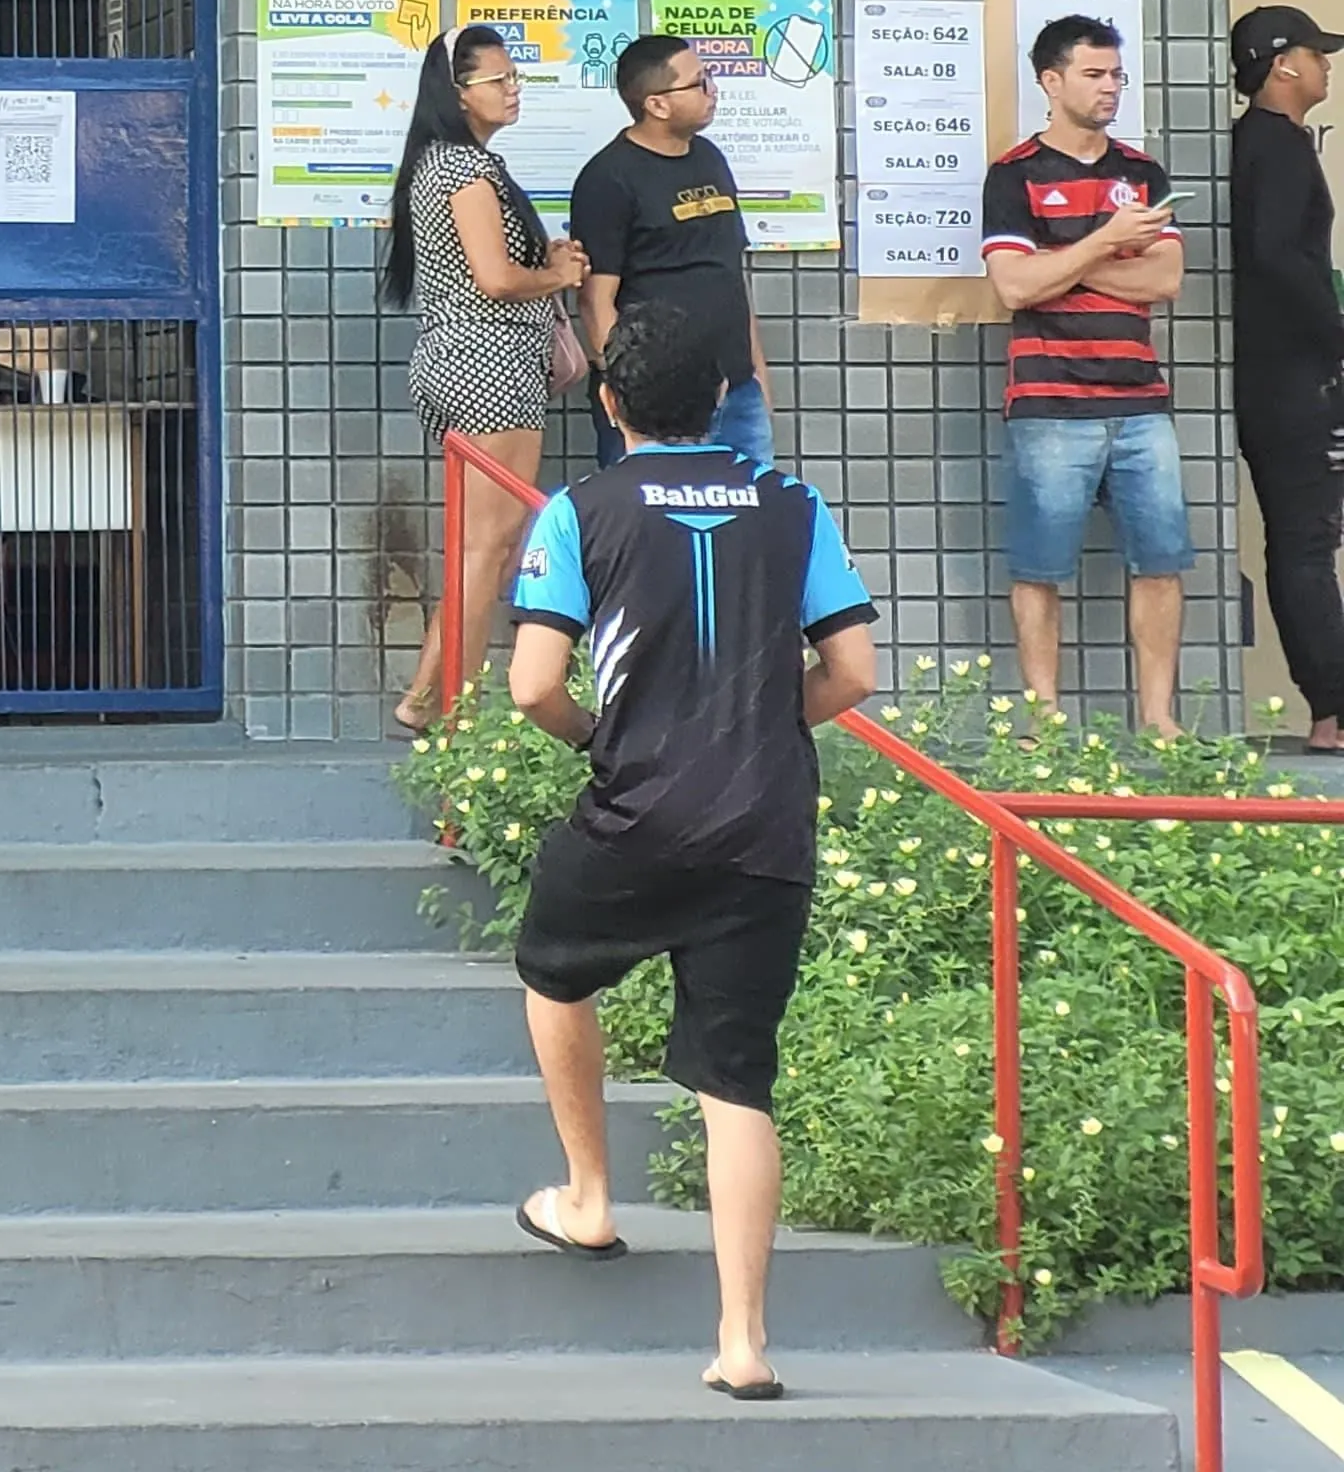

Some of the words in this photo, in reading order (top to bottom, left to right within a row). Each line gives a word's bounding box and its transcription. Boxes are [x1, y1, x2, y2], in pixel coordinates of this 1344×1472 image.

[273, 0, 292, 9] NA
[295, 0, 333, 9] HORA
[335, 0, 354, 9] DO
[357, 0, 395, 10] VOTO
[272, 13, 310, 24] LEVE
[312, 13, 322, 24] A
[470, 5, 608, 21] PREFERÊNCIA
[665, 7, 723, 19] NADA
[729, 7, 755, 19] DE
[665, 22, 757, 35] CELULAR
[872, 26, 929, 43] SEÇÃO:
[932, 26, 969, 41] 642
[696, 40, 749, 54] HORA
[883, 65, 929, 77] SALA:
[932, 63, 957, 78] 08
[873, 117, 931, 134] SEÇÃO:
[934, 118, 971, 133] 646
[885, 157, 931, 169] SALA:
[934, 155, 959, 170] 09
[875, 209, 932, 227] SEÇÃO:
[935, 210, 971, 225] 720
[886, 250, 932, 262] SALA:
[936, 248, 959, 263] 10
[640, 484, 760, 508] BahGui
